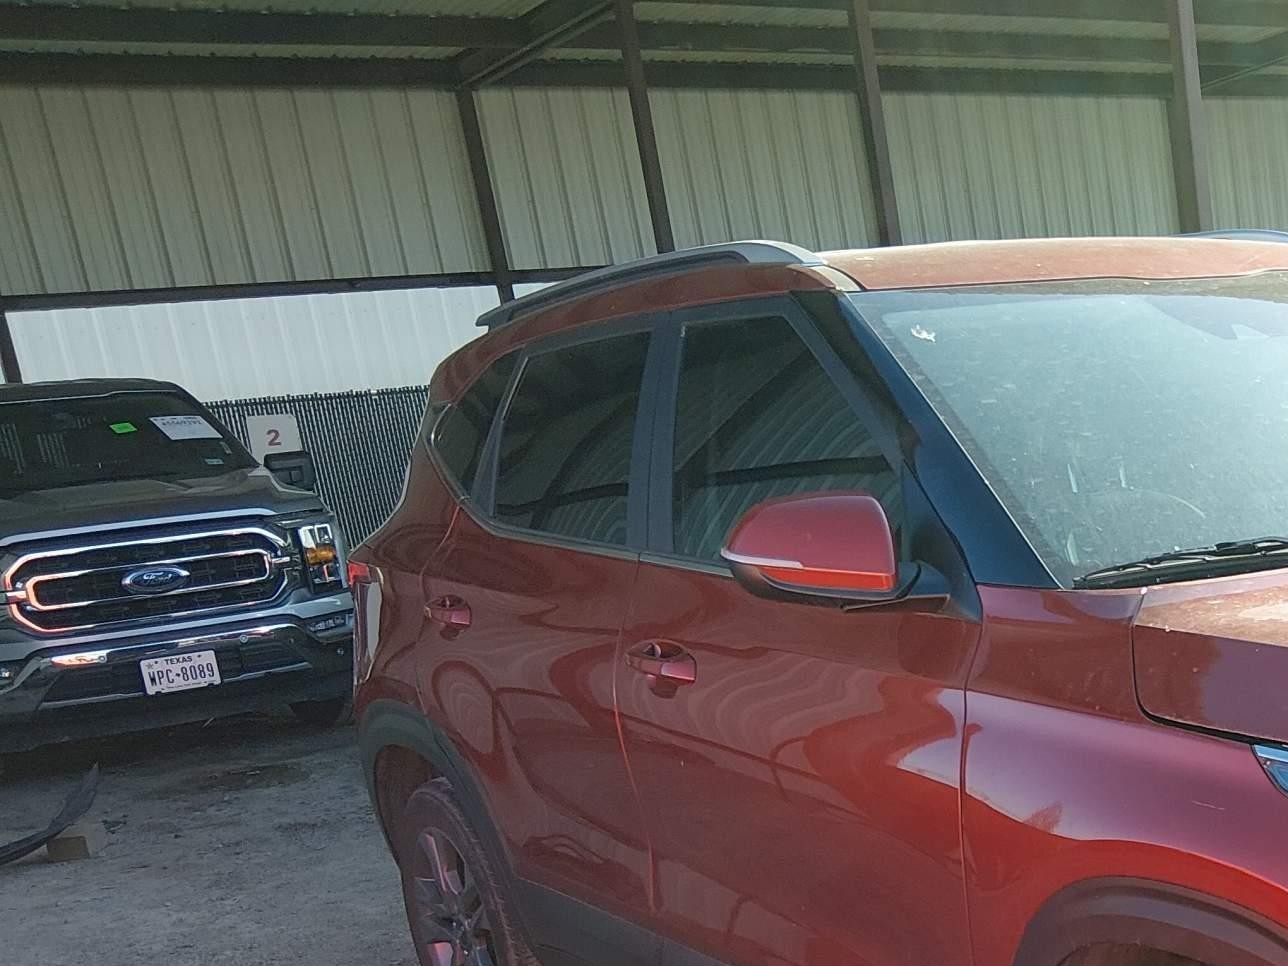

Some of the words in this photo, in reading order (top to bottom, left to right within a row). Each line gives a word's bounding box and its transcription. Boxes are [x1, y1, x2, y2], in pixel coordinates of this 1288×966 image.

[266, 429, 282, 446] 2
[142, 571, 173, 585] Ford
[165, 655, 193, 666] TEXAS
